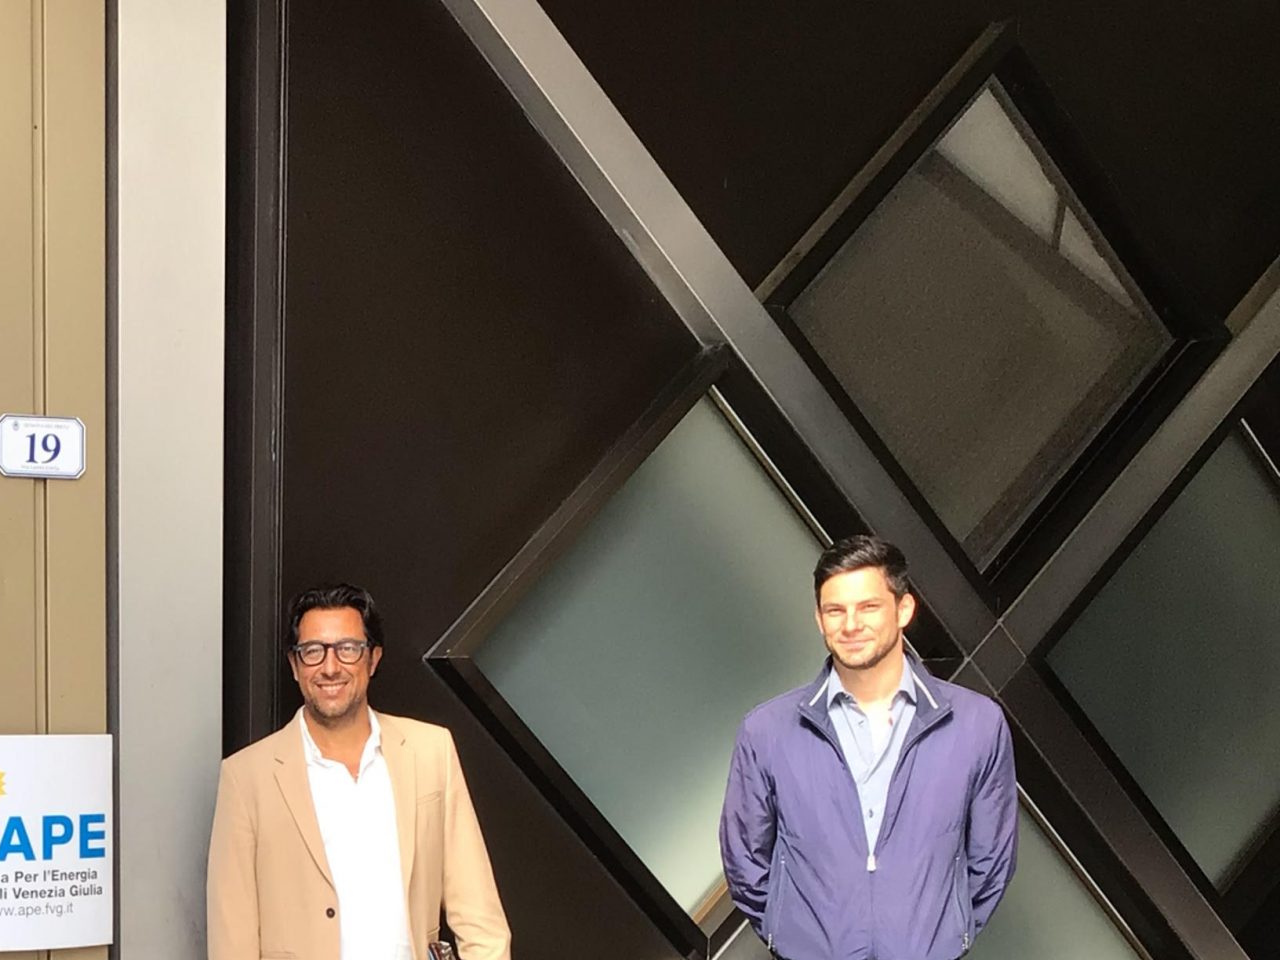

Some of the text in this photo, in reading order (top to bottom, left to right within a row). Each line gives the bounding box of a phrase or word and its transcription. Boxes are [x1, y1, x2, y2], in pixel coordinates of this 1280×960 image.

[25, 432, 61, 464] 19
[14, 870, 39, 883] Per
[43, 868, 98, 883] l'Energia
[12, 886, 65, 899] Venezia
[69, 884, 103, 897] Giulia
